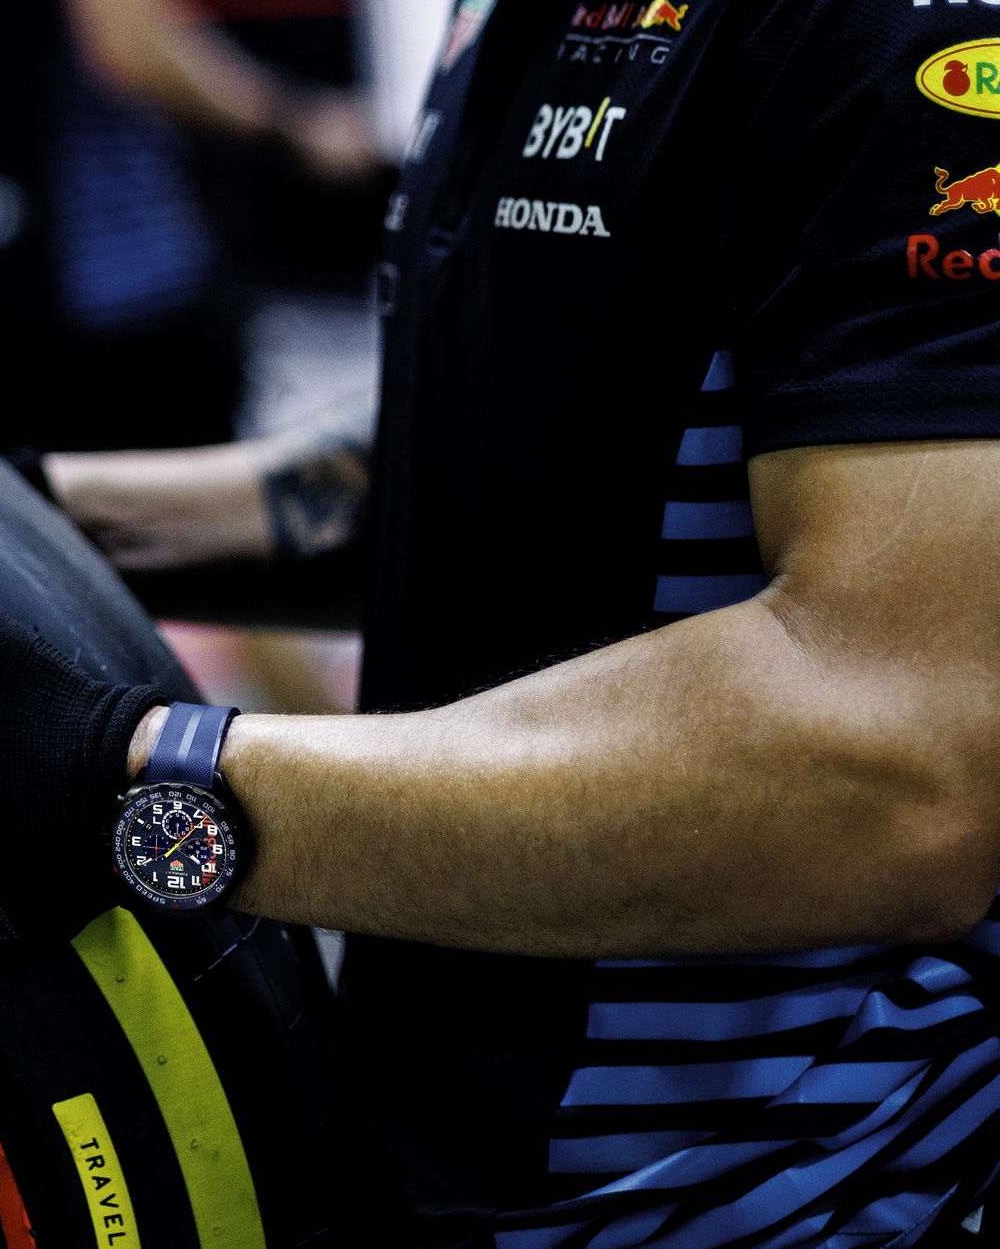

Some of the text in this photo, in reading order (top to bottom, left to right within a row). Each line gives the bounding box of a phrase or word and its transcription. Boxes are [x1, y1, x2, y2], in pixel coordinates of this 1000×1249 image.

[522, 96, 627, 162] BYBIT
[494, 197, 611, 238] HONDA
[153, 805, 162, 814] 5
[207, 825, 217, 835] 8
[132, 837, 141, 846] 3
[213, 845, 223, 853] 9
[167, 876, 185, 889] 12
[191, 876, 201, 886] 11
[136, 884, 165, 904] SPEED
[80, 1137, 126, 1247] TRAVEL
